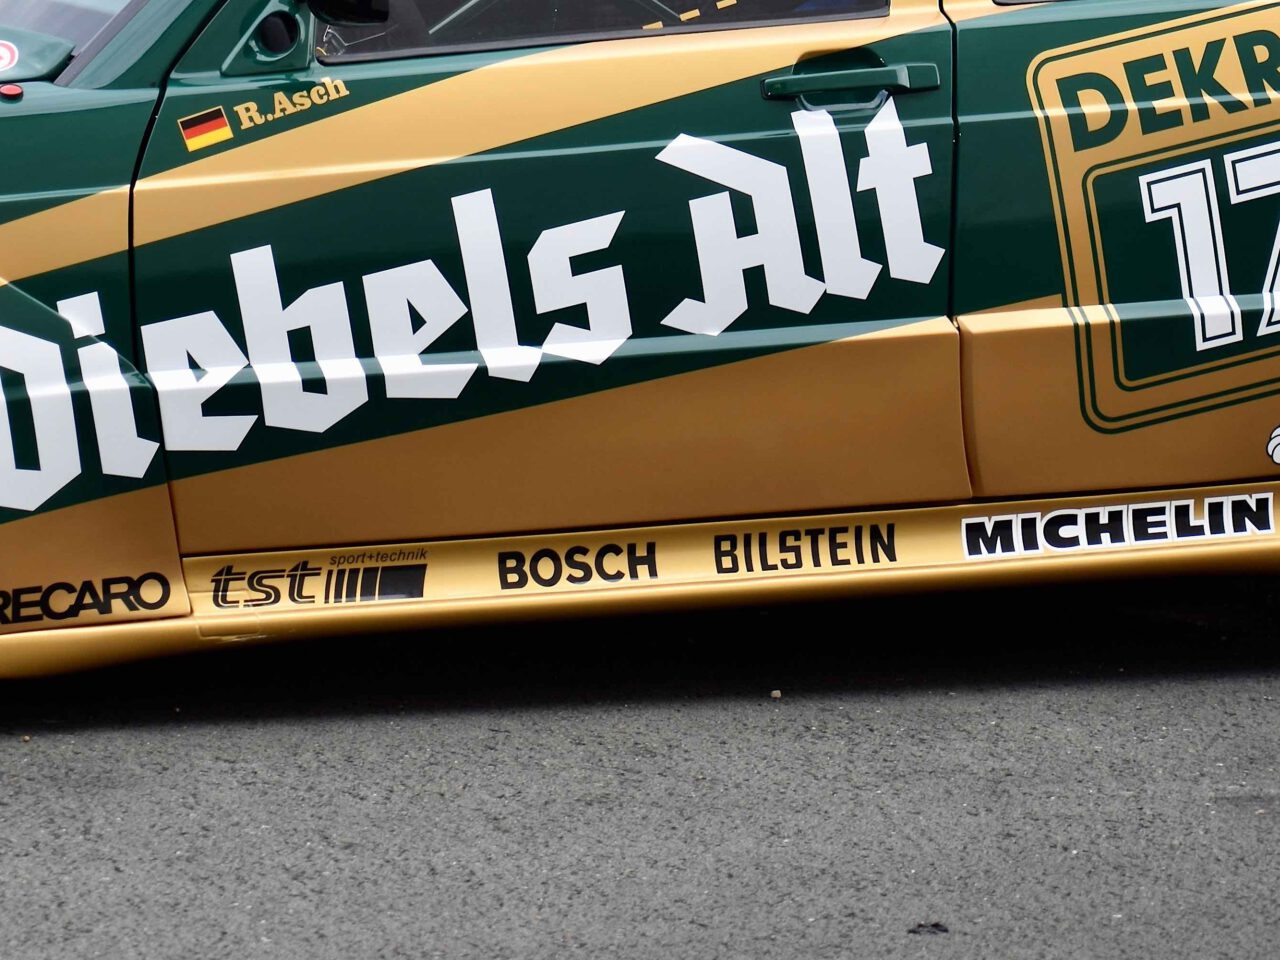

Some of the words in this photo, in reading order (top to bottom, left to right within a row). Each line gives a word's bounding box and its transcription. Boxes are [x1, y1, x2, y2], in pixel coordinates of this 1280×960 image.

[232, 76, 350, 130] R.Asch
[653, 96, 946, 336] Alt
[714, 523, 897, 574] BILSTEIN
[962, 492, 1274, 559] MICHELIN
[210, 560, 322, 610] tst
[328, 548, 428, 566] sport+technik
[498, 542, 658, 590] BOSCH
